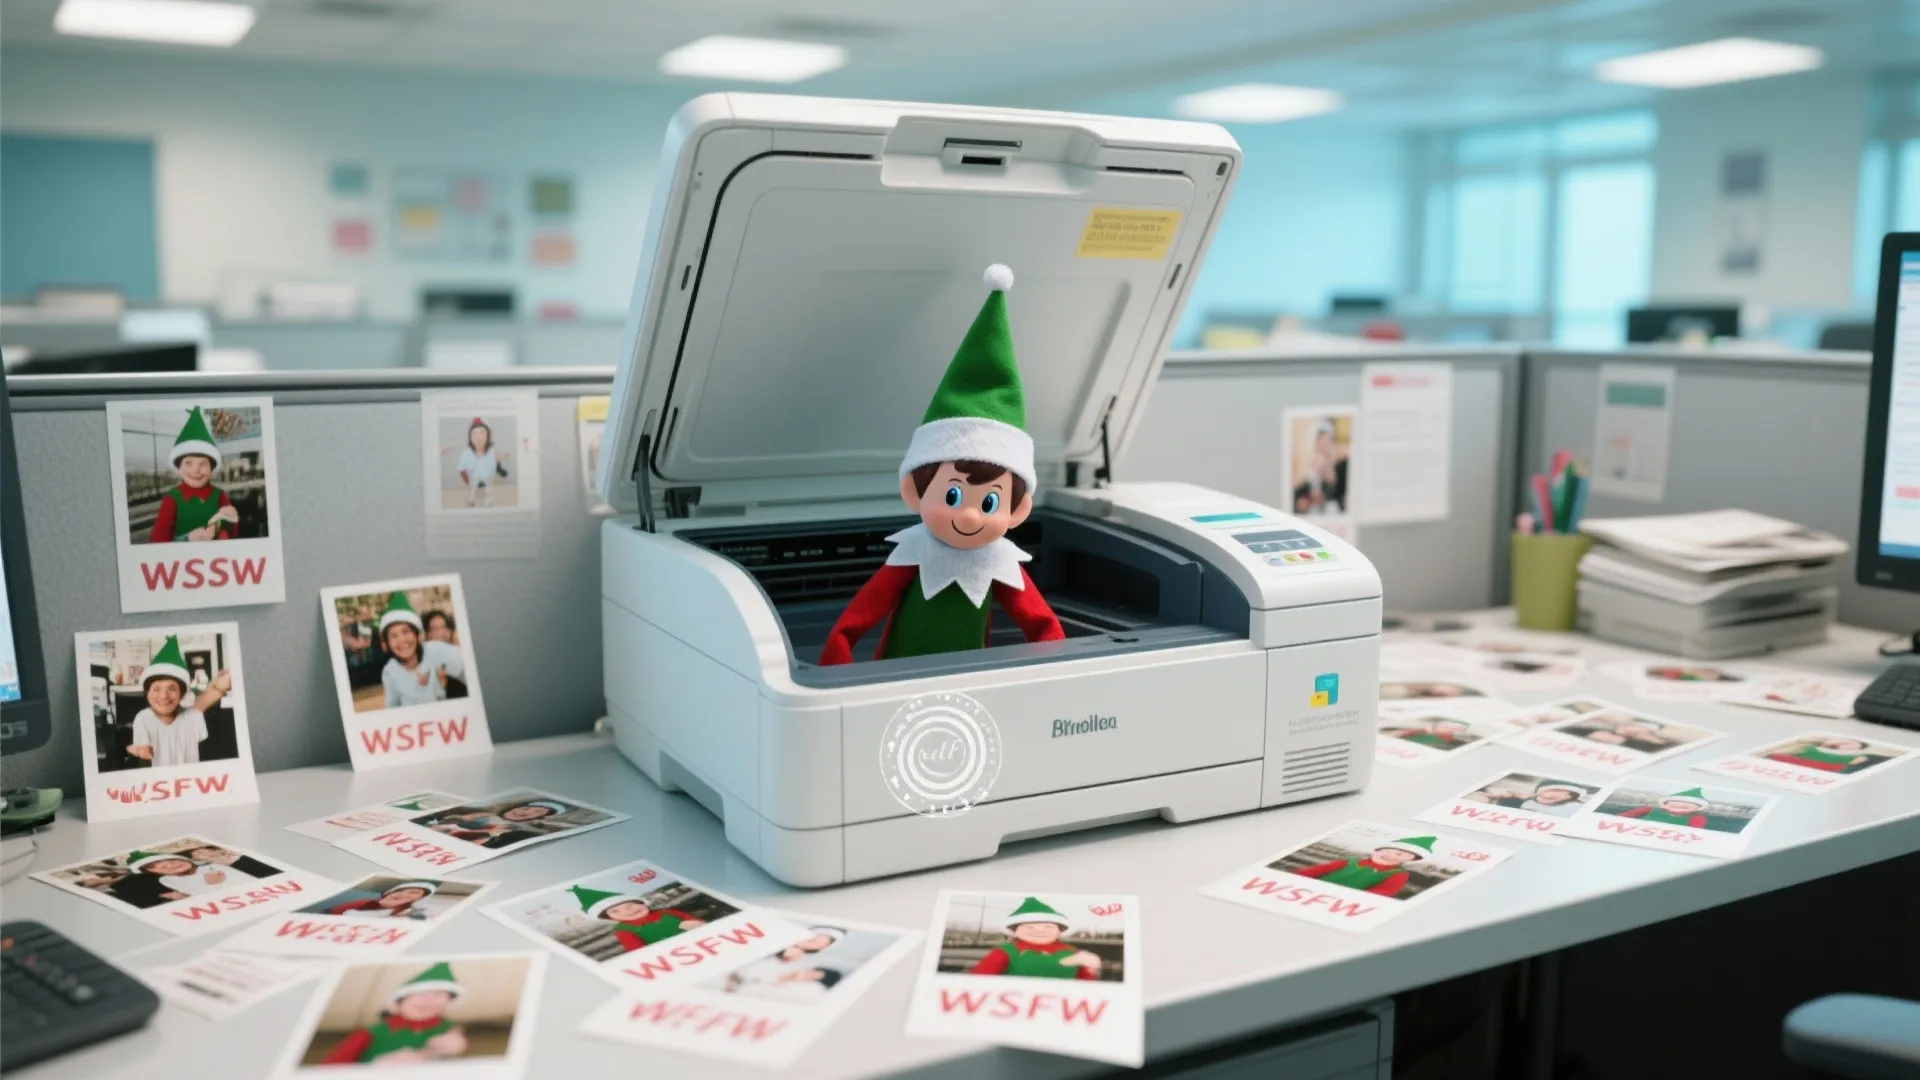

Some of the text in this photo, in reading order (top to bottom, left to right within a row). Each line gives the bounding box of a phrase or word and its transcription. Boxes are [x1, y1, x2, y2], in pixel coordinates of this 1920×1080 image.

[140, 557, 267, 591] WSSW
[360, 716, 468, 755] WSFW
[1241, 876, 1376, 917] WSFW
[622, 922, 765, 981] WSFW
[939, 988, 1109, 1024] WSFW
